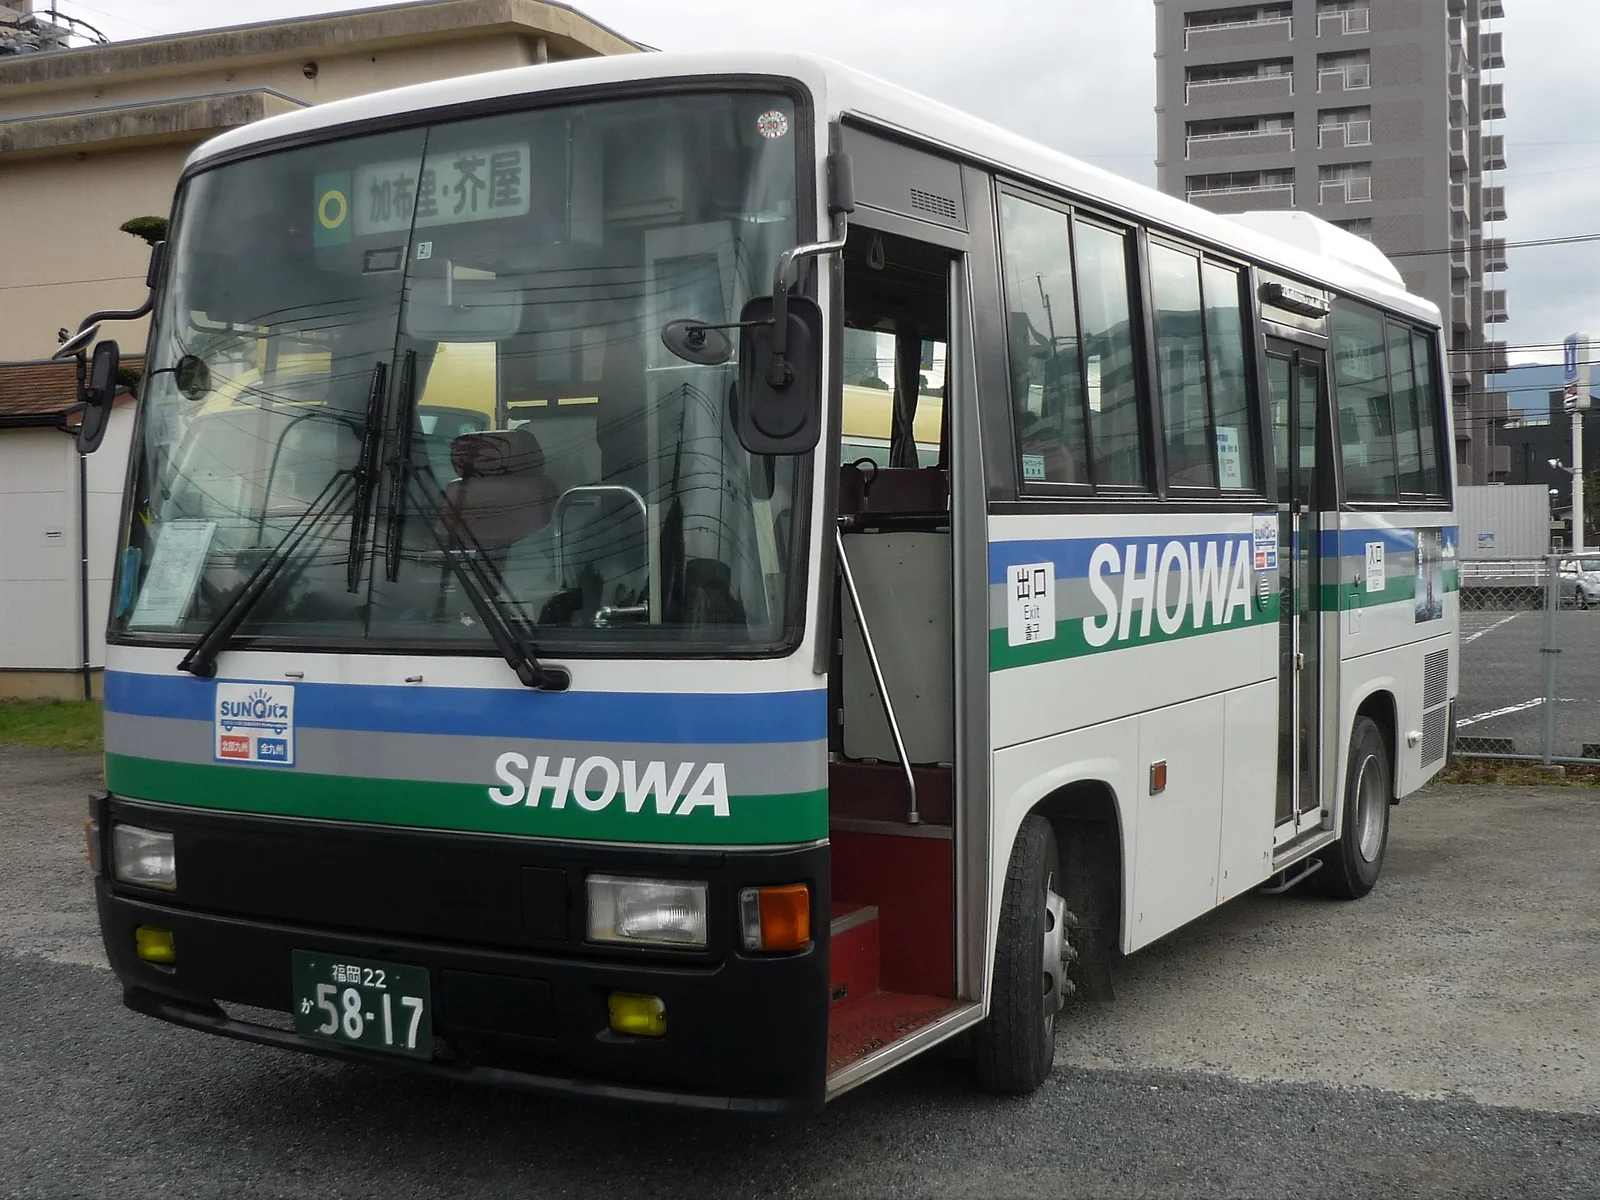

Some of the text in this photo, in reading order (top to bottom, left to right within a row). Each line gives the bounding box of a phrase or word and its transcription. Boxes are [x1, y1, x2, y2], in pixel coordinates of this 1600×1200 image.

[1017, 568, 1046, 601] 出口
[1083, 540, 1252, 647] SHOWA
[1024, 604, 1040, 620] Exit
[260, 743, 285, 756] 全九州
[489, 752, 731, 817] SHOWA
[317, 983, 423, 1048] 58-17
